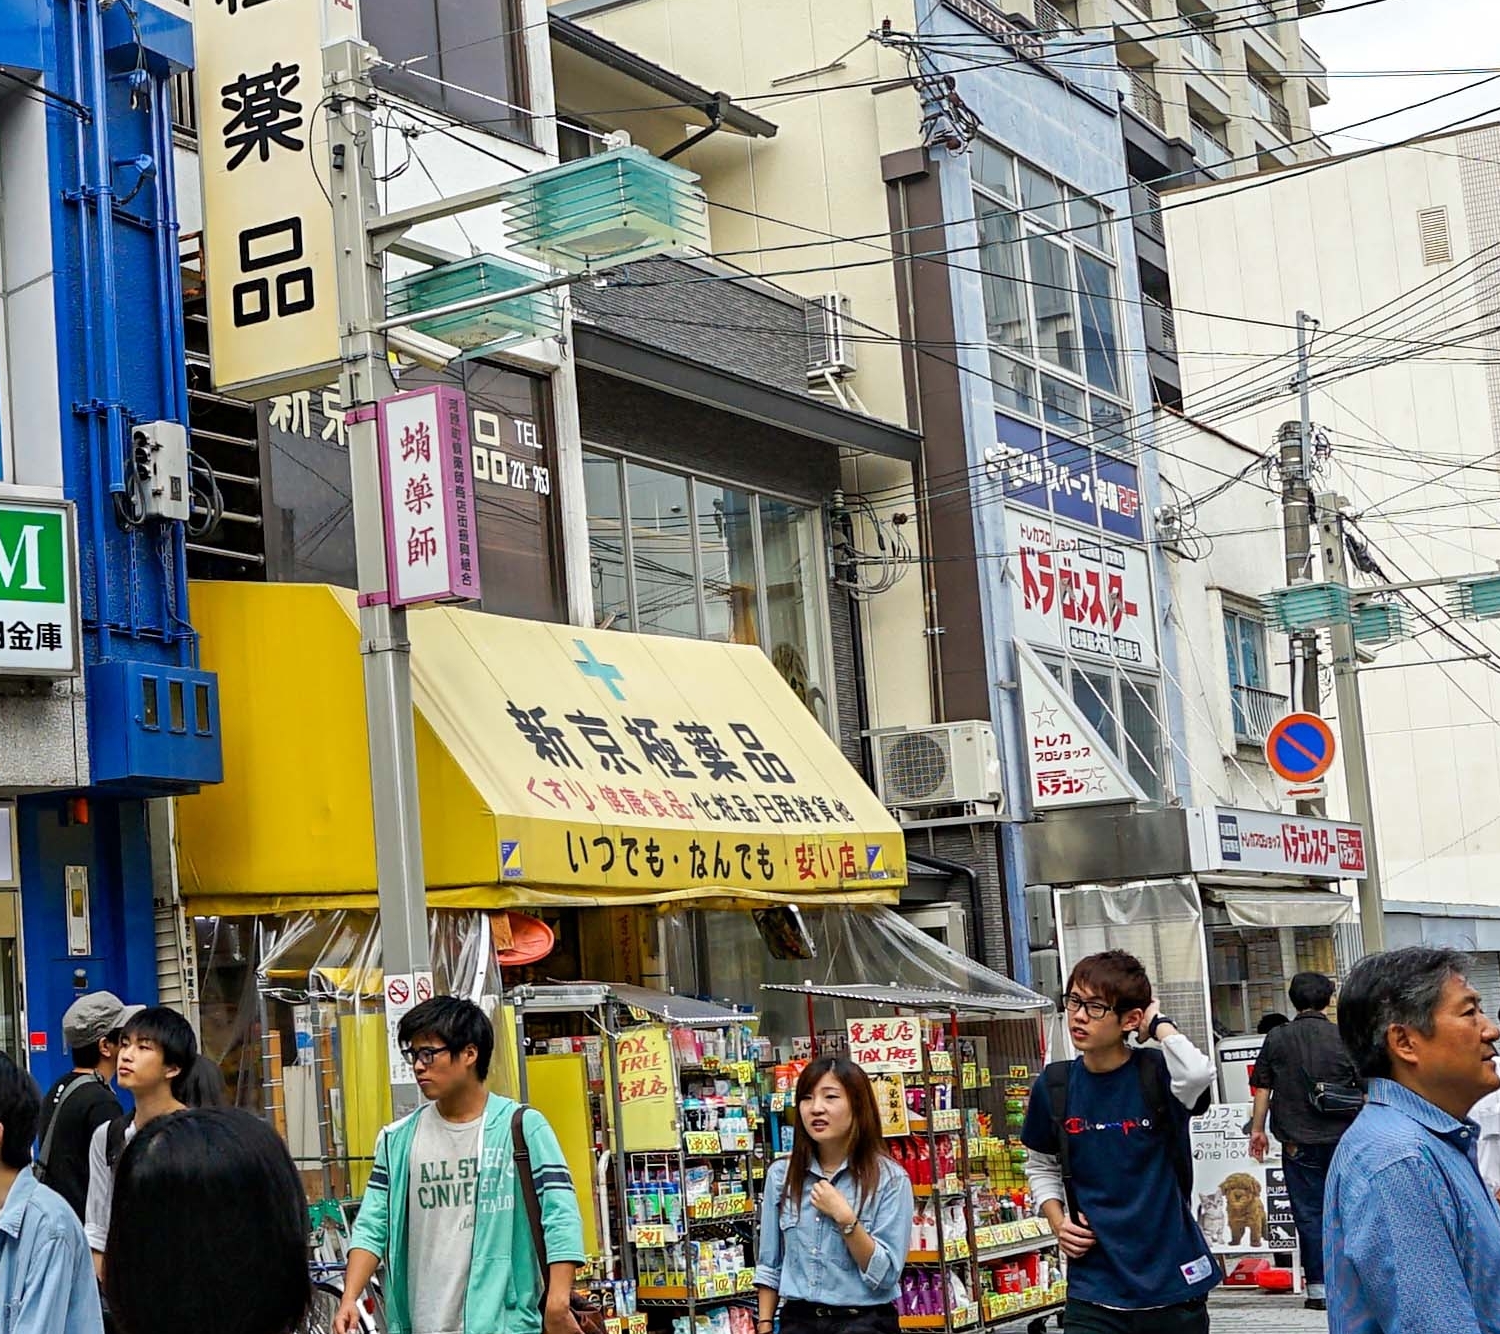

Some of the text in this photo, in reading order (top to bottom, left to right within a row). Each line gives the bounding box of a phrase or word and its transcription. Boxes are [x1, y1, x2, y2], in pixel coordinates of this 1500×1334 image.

[514, 418, 543, 450] TEL
[506, 700, 796, 784] 新京極薬品
[1034, 732, 1072, 748] トレカ
[1037, 778, 1084, 797] ドラゴン
[620, 1052, 660, 1075] FREE
[852, 1048, 881, 1063] TAX
[420, 1161, 454, 1185] ALL
[1269, 1213, 1294, 1223] KITTY
